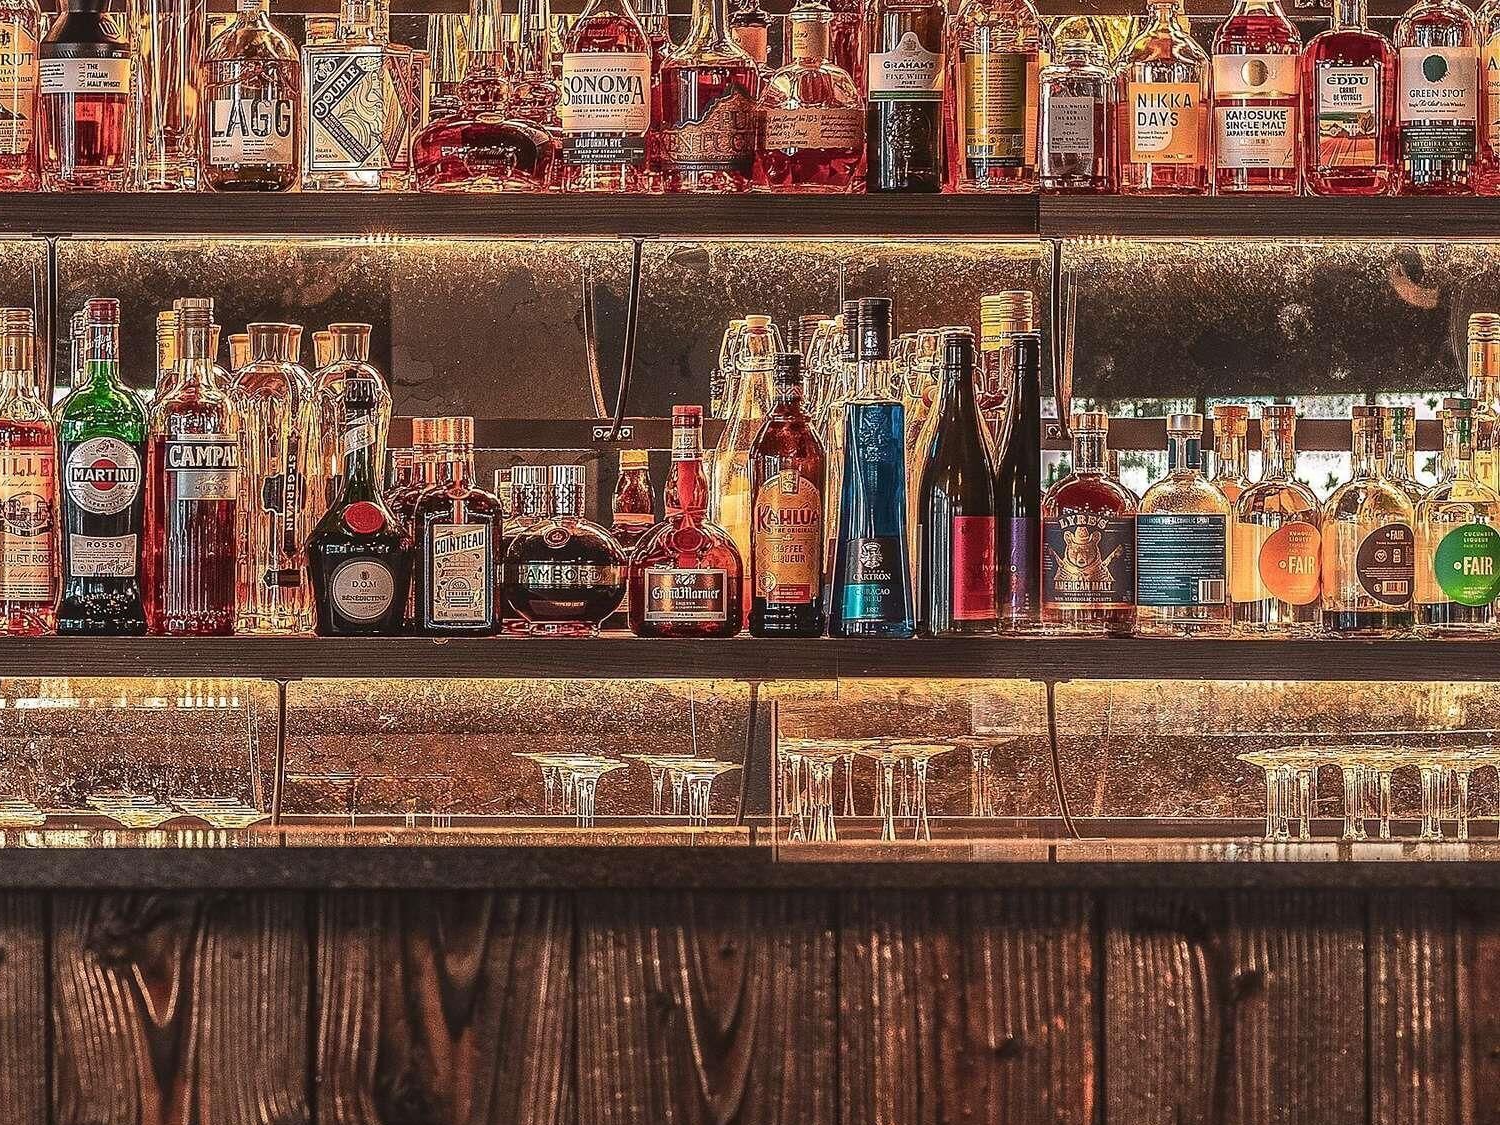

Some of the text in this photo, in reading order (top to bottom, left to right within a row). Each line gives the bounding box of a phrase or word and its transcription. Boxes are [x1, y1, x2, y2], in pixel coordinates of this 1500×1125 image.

[1326, 76, 1369, 85] EDDU
[314, 65, 359, 118] DOUBLE
[563, 75, 645, 106] SONOMA
[1409, 89, 1466, 97] GREEN SPOT
[572, 94, 616, 104] DISTILLING
[1138, 93, 1192, 108] NIKKA
[212, 100, 290, 137] LAGG
[1138, 112, 1179, 127] DAYS
[1226, 111, 1286, 120] KANOSUKE
[1226, 121, 1286, 129] SINGLE MALT
[575, 139, 622, 147] CALIFORNIA RYE
[73, 469, 135, 481] MARTINI
[284, 454, 297, 532] ST-GERMAIN
[757, 503, 820, 534] KAHLÚA
[1059, 515, 1109, 529] LYRE'S
[1390, 530, 1404, 540] FAIR
[434, 530, 484, 555] COINTREAU
[773, 544, 803, 552] COFFEE
[32, 554, 50, 563] ROS
[1288, 556, 1316, 574] FAIR
[1463, 556, 1493, 575] FAIR
[526, 570, 601, 582] AMBORD
[1054, 581, 1091, 590] AMERICAN
[681, 586, 720, 599] Marnier
